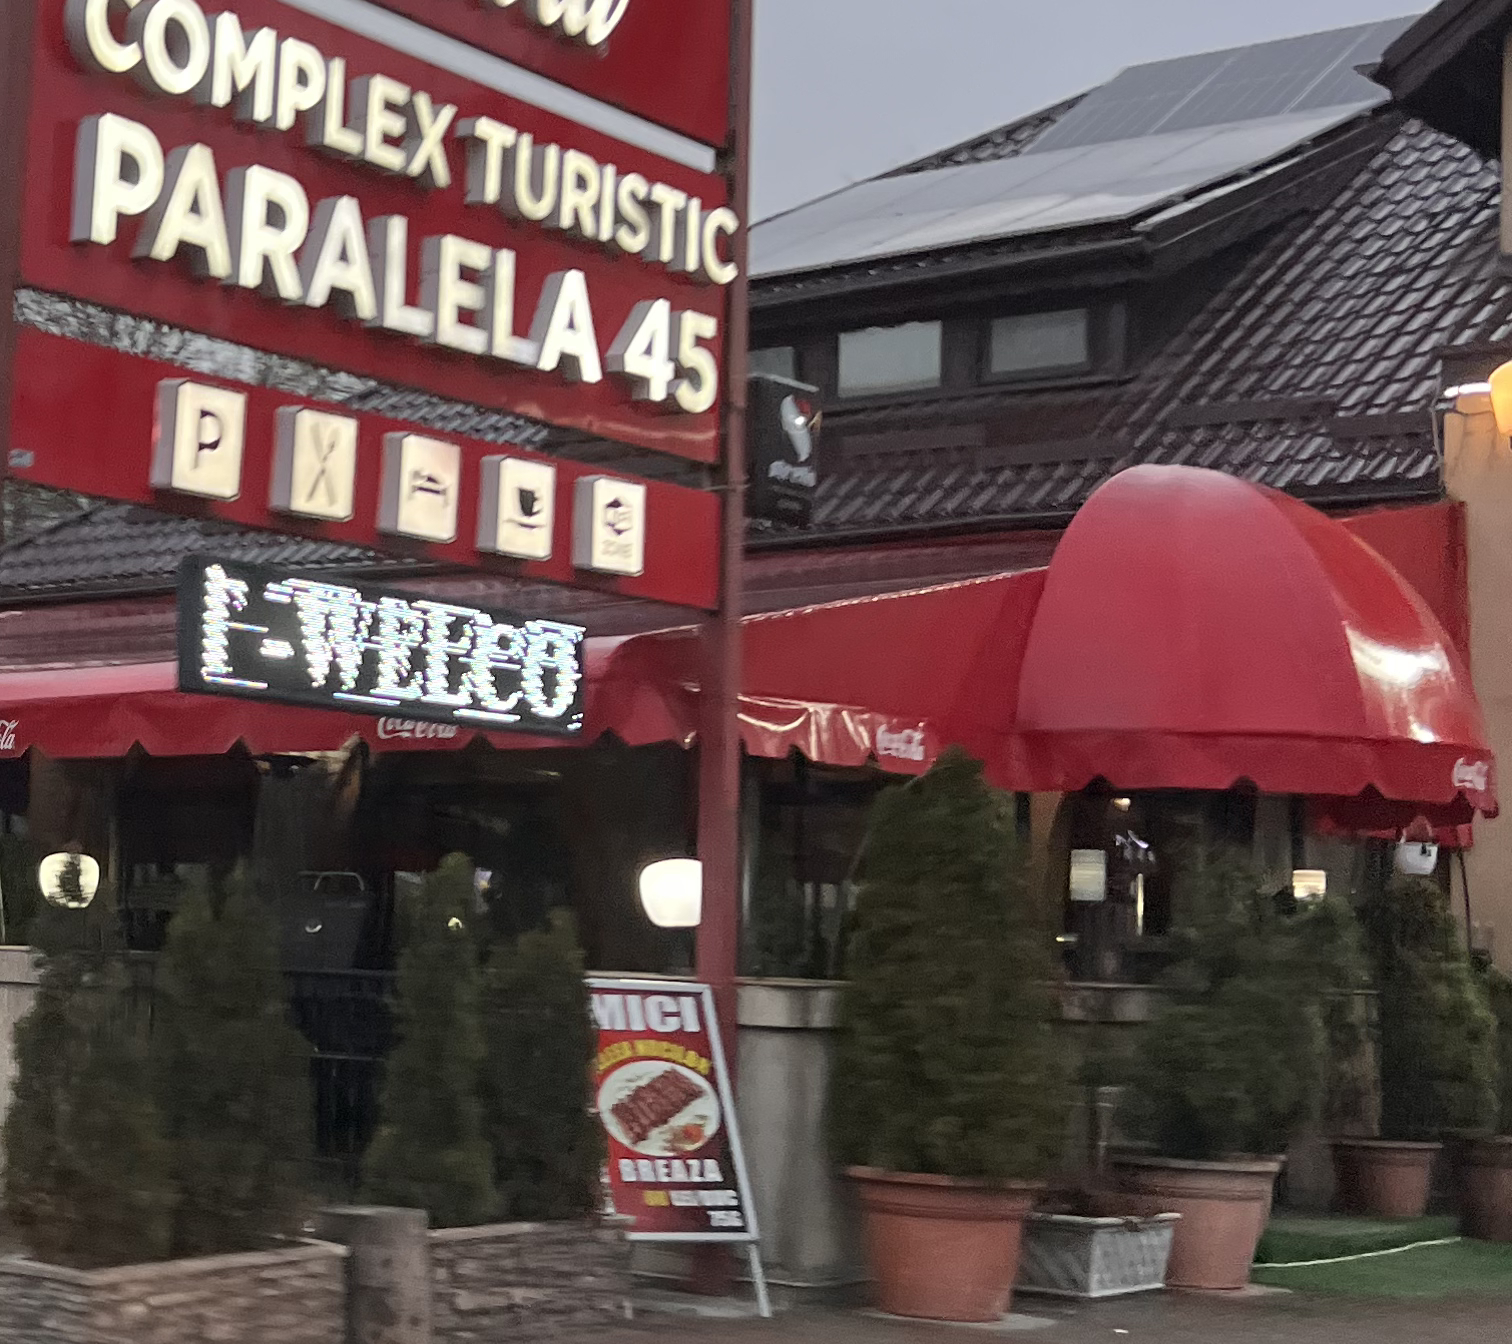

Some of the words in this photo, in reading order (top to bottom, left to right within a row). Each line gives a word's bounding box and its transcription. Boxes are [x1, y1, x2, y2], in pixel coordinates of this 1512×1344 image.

[86, 110, 603, 384] PARALELA
[616, 296, 719, 415] 45
[468, 115, 740, 286] TURISTIC
